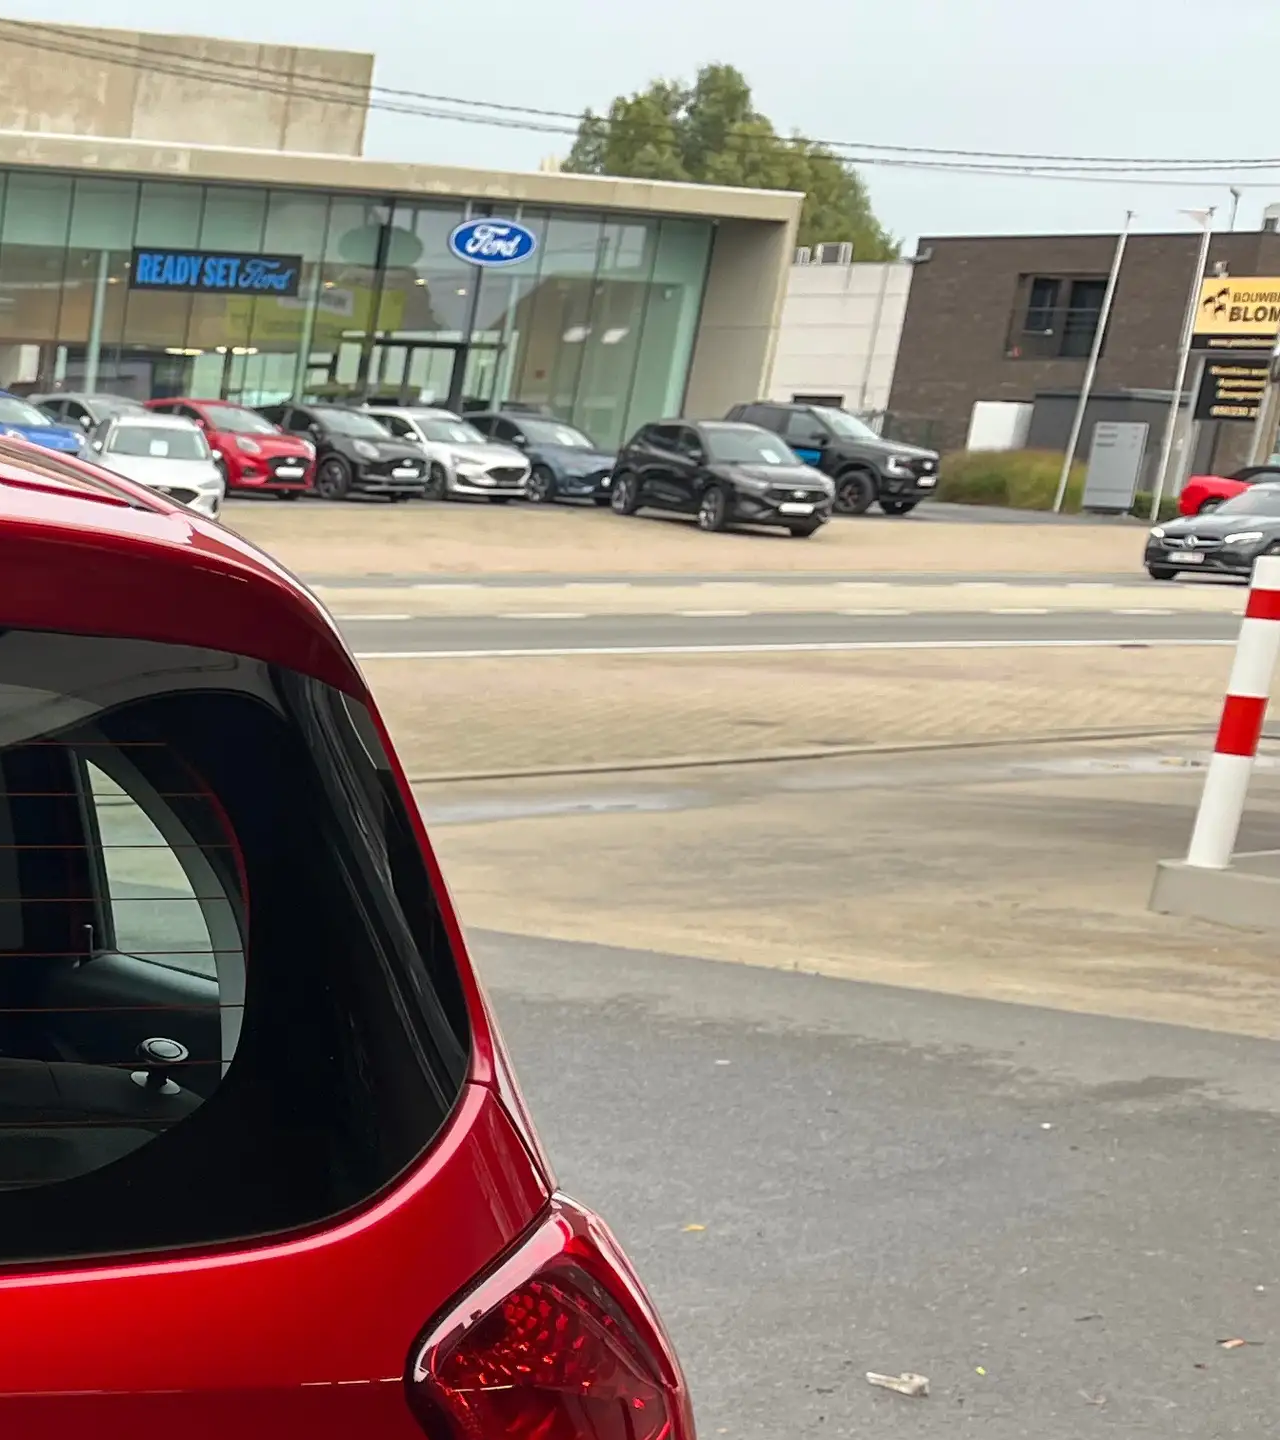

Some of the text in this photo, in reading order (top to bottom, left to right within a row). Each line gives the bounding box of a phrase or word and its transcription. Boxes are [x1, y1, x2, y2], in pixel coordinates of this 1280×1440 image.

[465, 224, 523, 258] Ford
[136, 253, 299, 291] READY SET Ford
